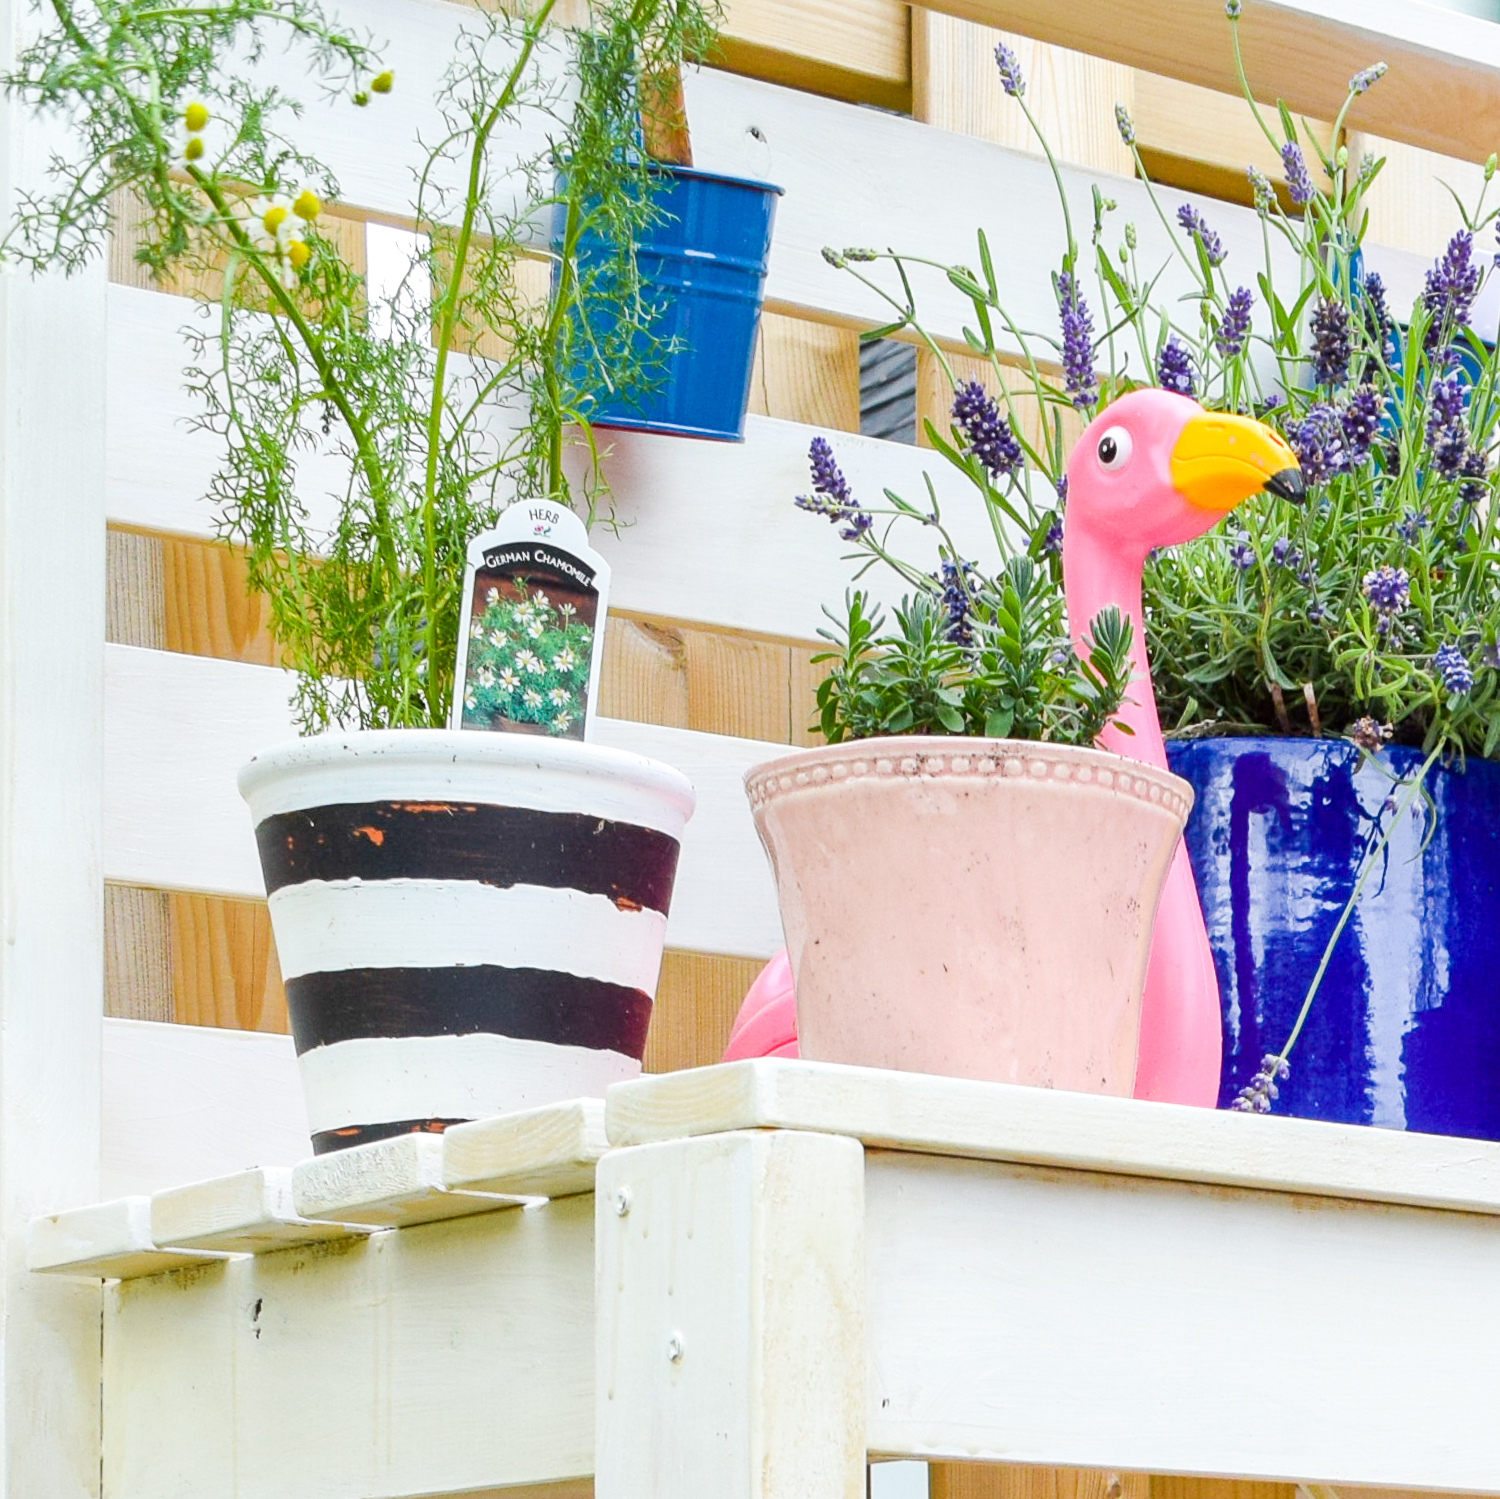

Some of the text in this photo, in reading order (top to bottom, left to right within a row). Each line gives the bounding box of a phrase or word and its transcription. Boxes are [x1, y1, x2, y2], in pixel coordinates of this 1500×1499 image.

[529, 508, 560, 524] HERB
[486, 549, 592, 587] GERMAN CHAMOMILE
